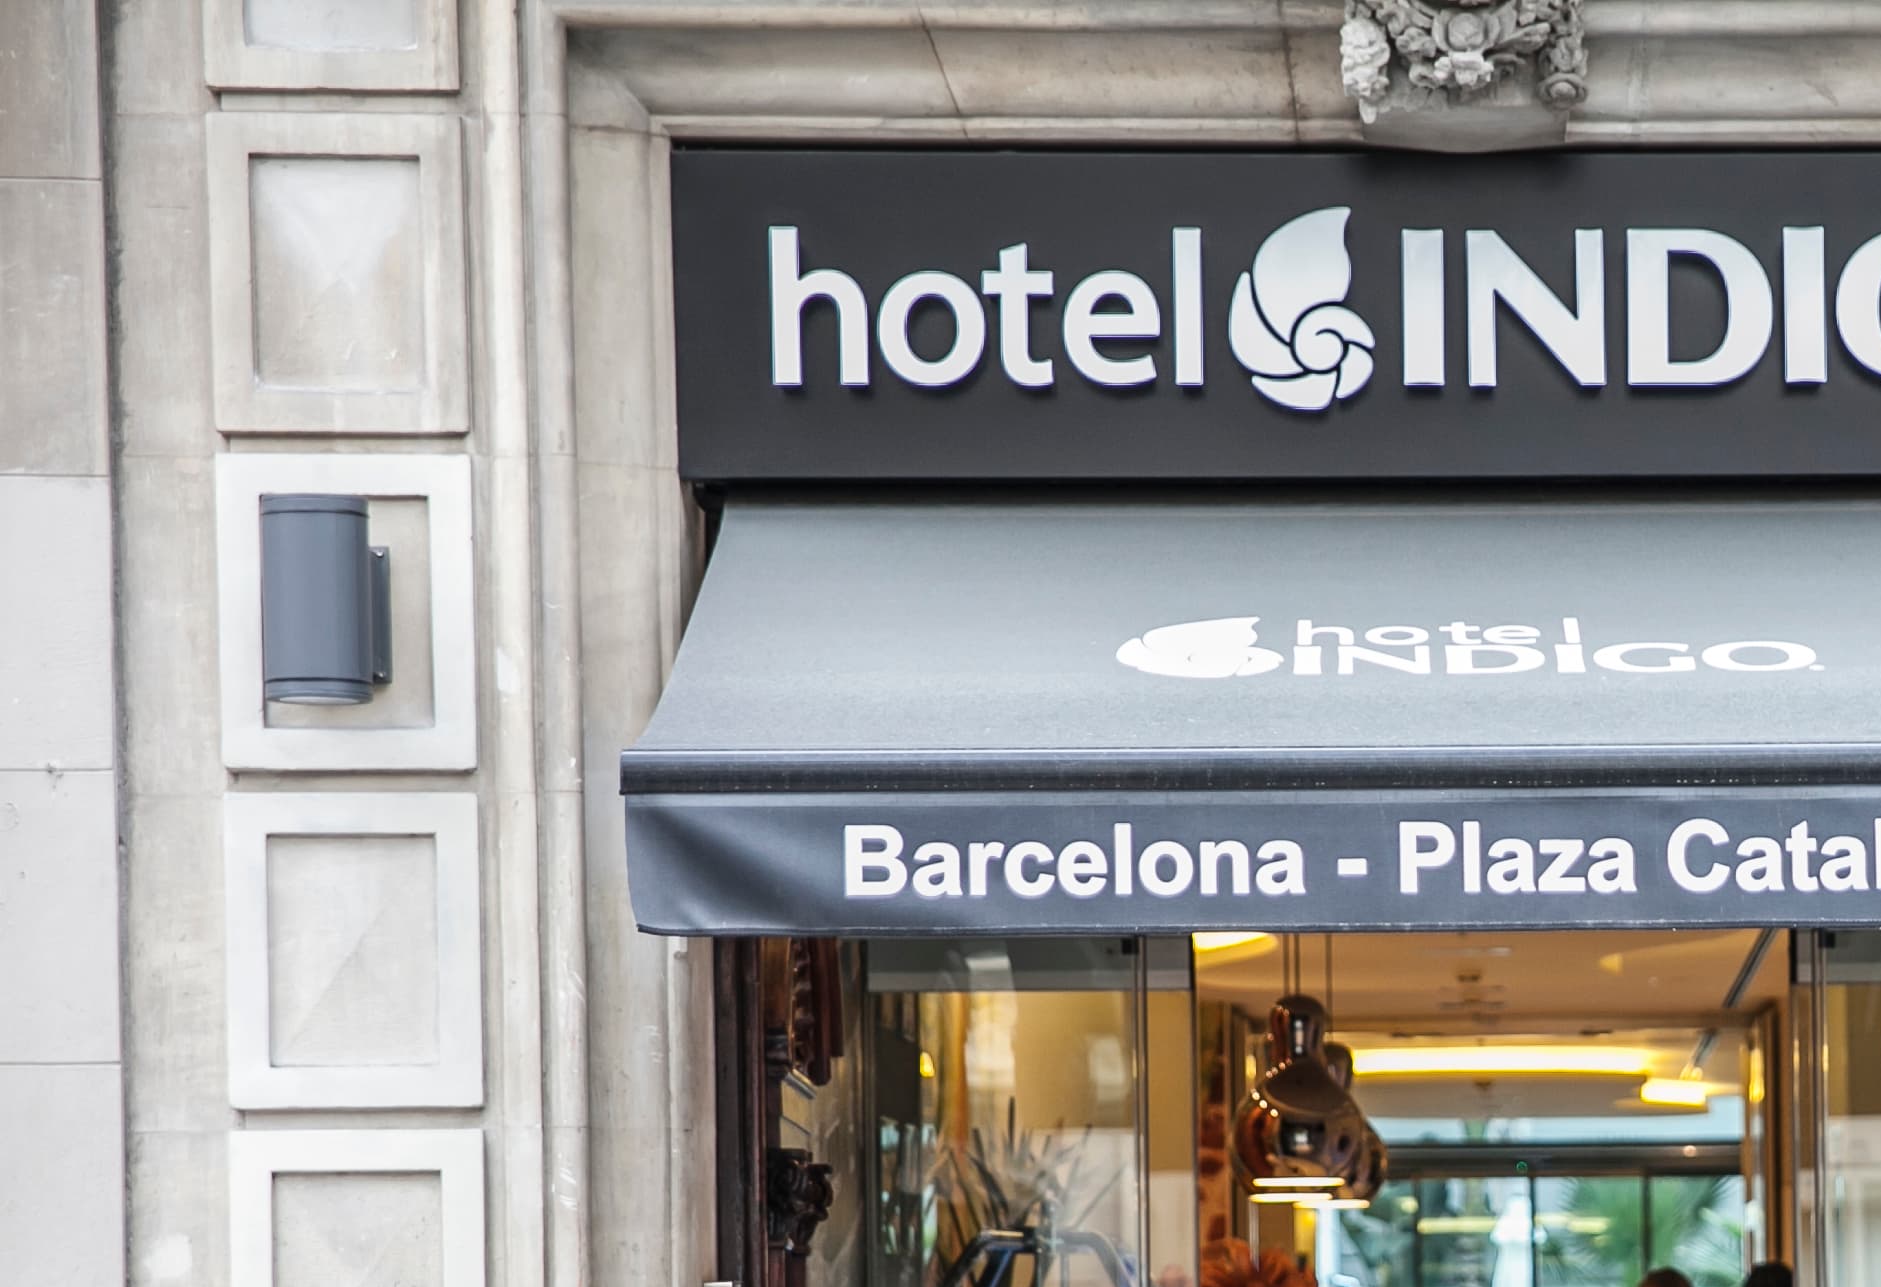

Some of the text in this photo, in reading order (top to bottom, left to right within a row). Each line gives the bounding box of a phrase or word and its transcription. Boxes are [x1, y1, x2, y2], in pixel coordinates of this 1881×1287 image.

[768, 226, 1204, 387] hotel
[1292, 638, 1818, 676] INDIGO
[1297, 616, 1586, 647] hotel
[844, 821, 1307, 901] Barcelona
[1336, 857, 1369, 879] -
[1399, 820, 1639, 896] Plaza
